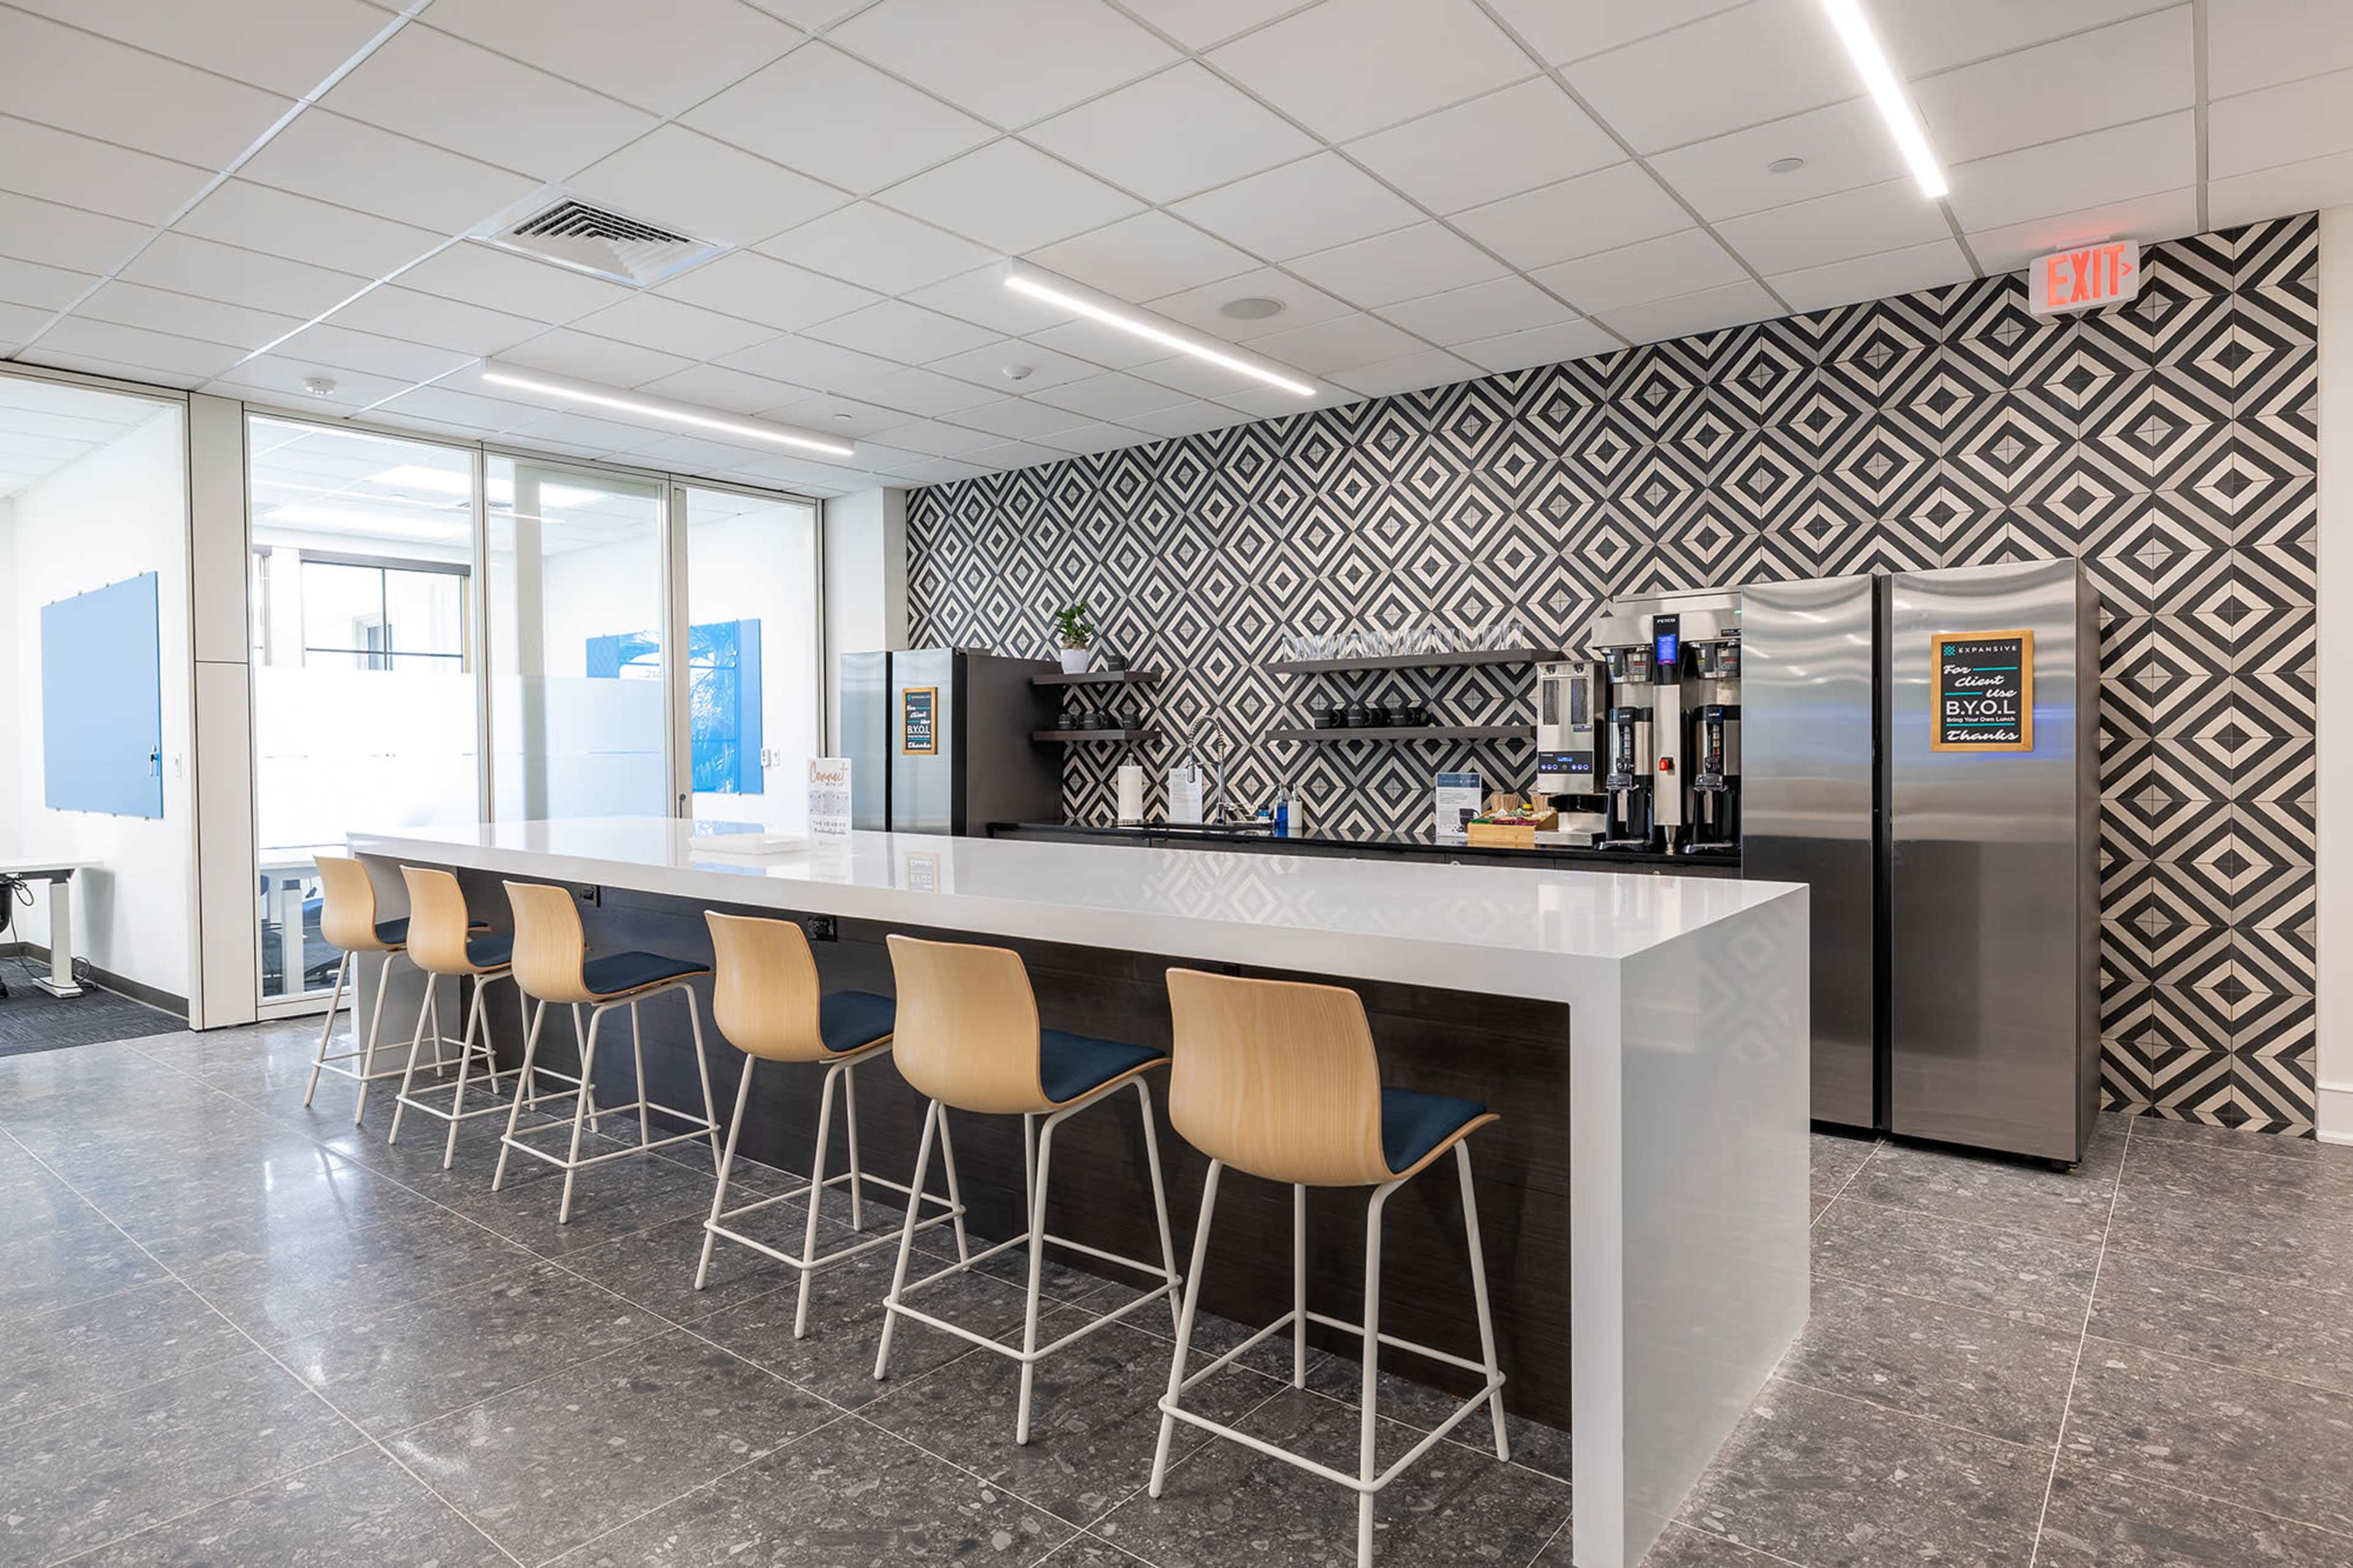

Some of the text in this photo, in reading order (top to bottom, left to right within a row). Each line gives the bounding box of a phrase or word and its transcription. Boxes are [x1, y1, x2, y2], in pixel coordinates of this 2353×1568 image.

[2047, 244, 2126, 307] EXIT
[1958, 645, 2017, 654] EXPANSIVE
[1943, 664, 1971, 675] For
[1985, 688, 2017, 697] Use
[1946, 700, 2016, 715] B.Y.O.L
[1946, 729, 2020, 741] Thanks
